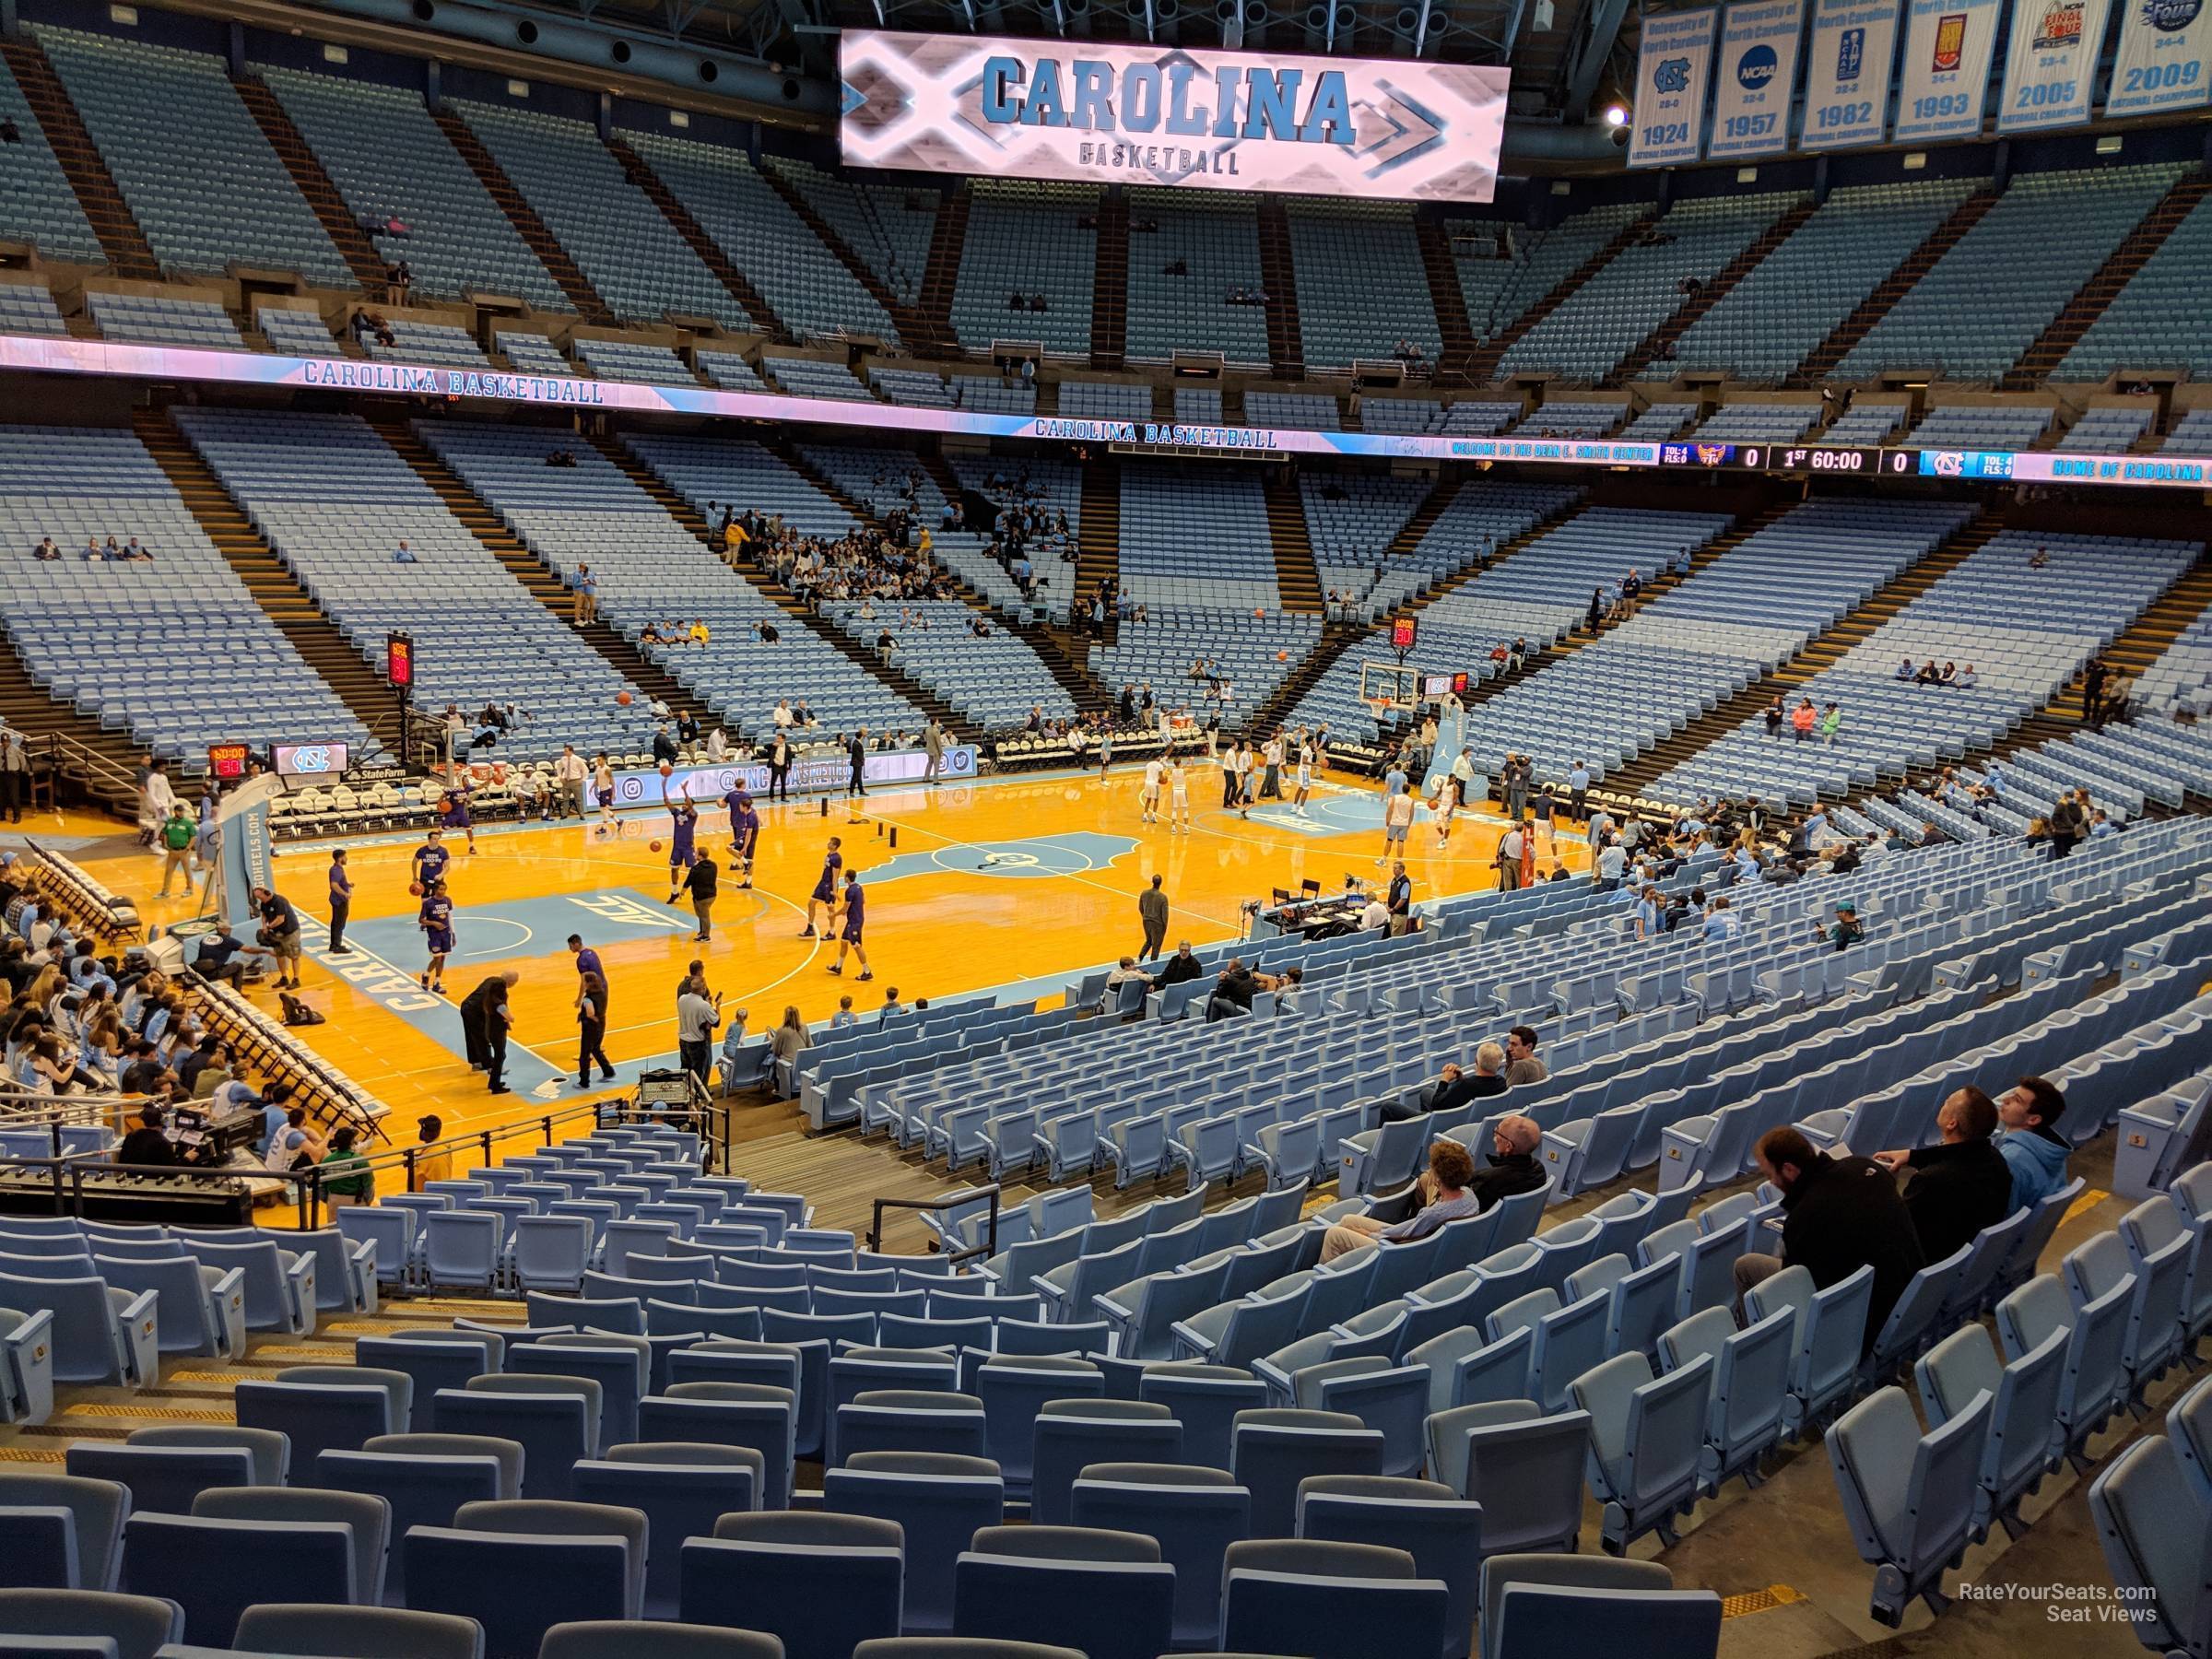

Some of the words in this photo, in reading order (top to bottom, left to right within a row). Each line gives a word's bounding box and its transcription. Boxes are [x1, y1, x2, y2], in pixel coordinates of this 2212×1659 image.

[2045, 10, 2081, 27] FINAL
[2154, 3, 2195, 18] FOUR
[2048, 23, 2081, 37] FOUR
[1740, 65, 1775, 80] NCAA
[2124, 61, 2201, 92] 2009
[982, 55, 1357, 145] CAROLINA
[2017, 80, 2076, 108] 2005
[1817, 101, 1873, 128] 1982
[1913, 93, 1969, 119] 1993
[1725, 112, 1777, 137] 1957
[1642, 123, 1688, 146] 1924
[1079, 142, 1241, 175] BASKETBALL
[303, 360, 438, 393] CAROLINA
[448, 371, 604, 404] BASKETBALL
[1034, 418, 1136, 442] CAROLINA
[1145, 423, 1277, 449] BASKETBALL
[1453, 441, 1496, 455] WELCOME
[1500, 443, 1511, 456] TO
[1514, 443, 1532, 457] THE
[1535, 444, 1560, 458] DEAN
[1576, 445, 1609, 459] SMITH
[1613, 446, 1653, 461] CENTER
[1665, 446, 1681, 455] TOL:
[1665, 454, 1680, 464] FLS:
[1746, 449, 1759, 467] 0
[1984, 455, 2005, 465] TOL:
[2005, 456, 2012, 465] 4
[1812, 451, 1862, 470] 60:00
[1893, 453, 1907, 472] 0
[1983, 465, 2003, 475] FLS:
[2004, 465, 2011, 476] 0
[2053, 460, 2095, 477] HOME
[2100, 461, 2119, 477] OF
[2124, 463, 2203, 481] CAROLINA
[1397, 628, 1411, 642] 30
[214, 747, 245, 759] 60:00
[217, 759, 240, 775] 30
[247, 812, 265, 888] GOHEELS.COM
[841, 1017, 849, 1028] 5
